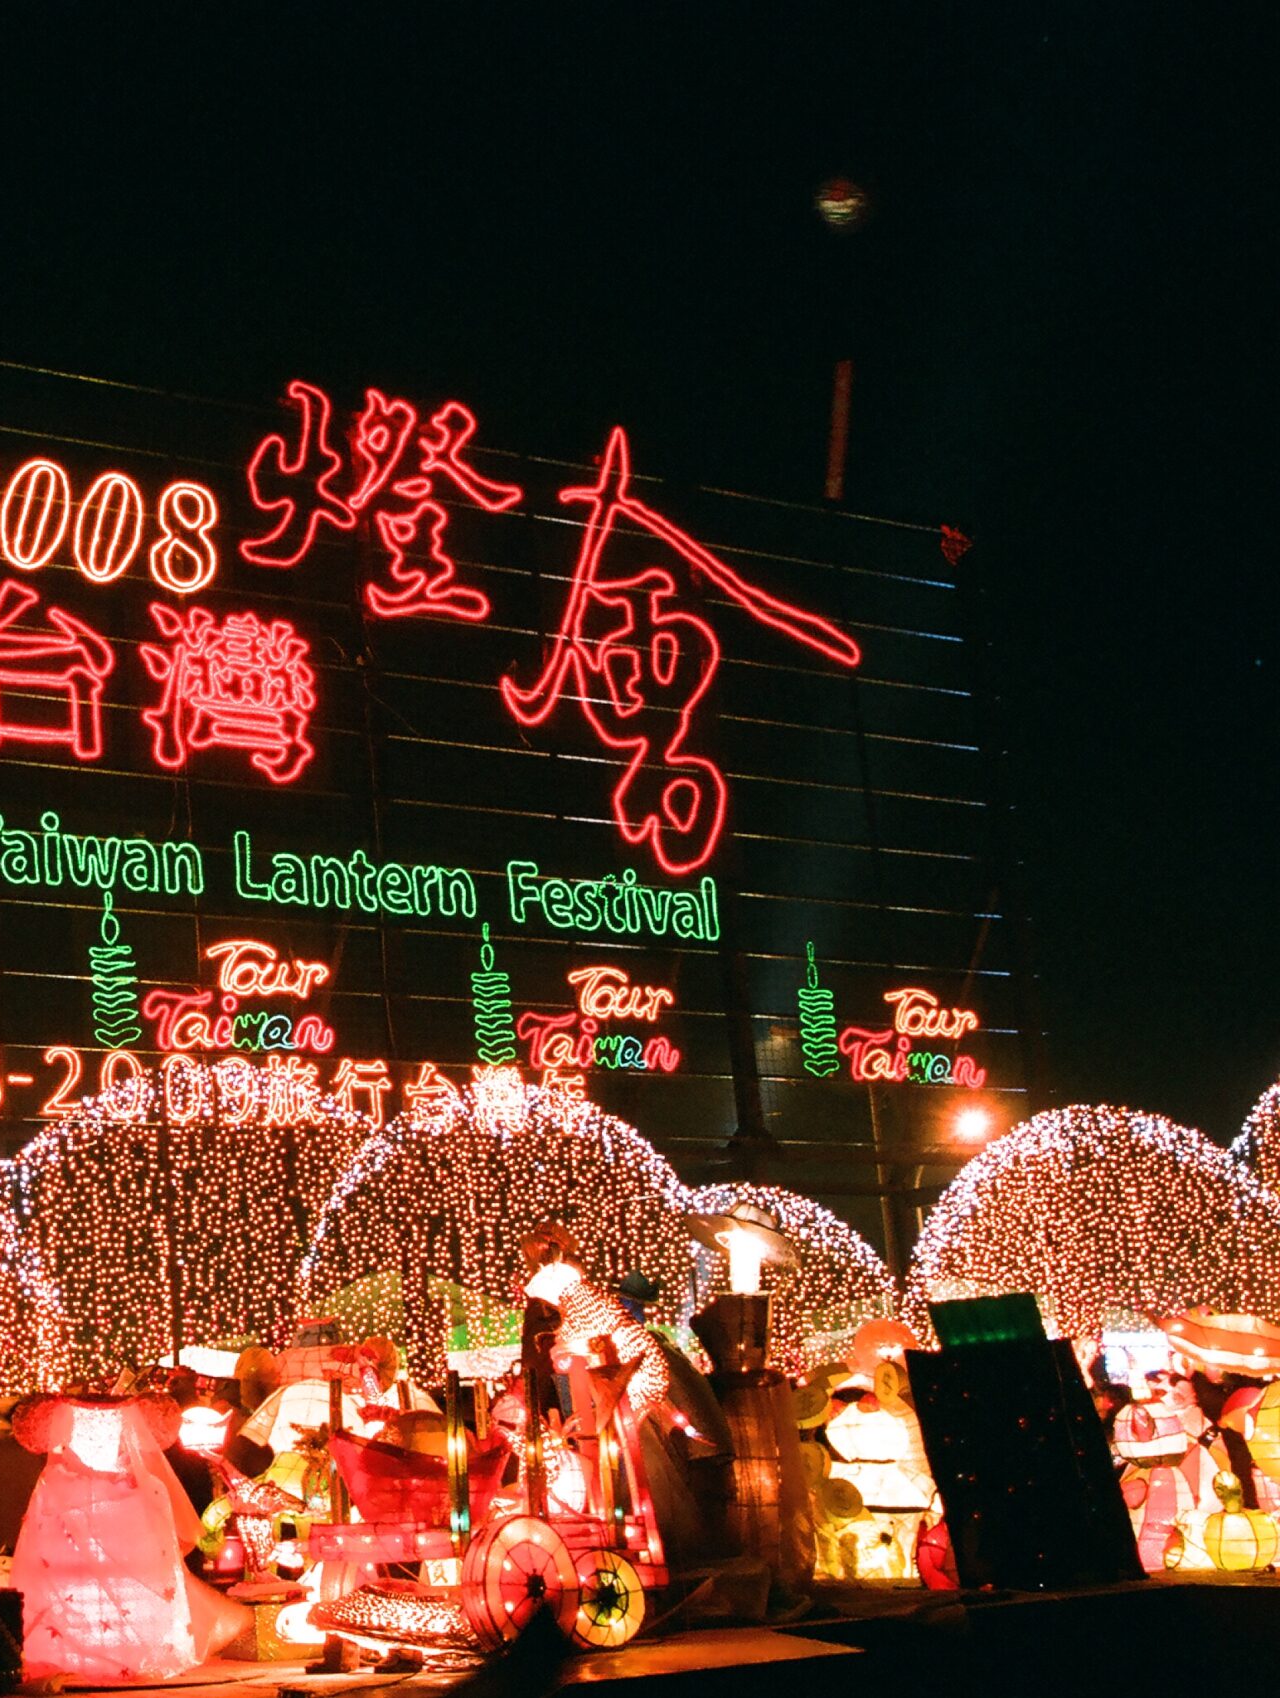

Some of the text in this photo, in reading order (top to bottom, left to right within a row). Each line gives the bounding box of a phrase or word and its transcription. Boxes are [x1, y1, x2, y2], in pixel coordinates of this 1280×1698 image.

[234, 831, 477, 917] Lantern
[507, 861, 720, 941] Festival
[206, 940, 330, 998] Tour
[567, 966, 674, 1021] Tour
[142, 989, 334, 1053] Taiwan
[517, 1011, 680, 1072] Taiwan
[883, 988, 979, 1039] Tour
[838, 1027, 987, 1088] Taiwan
